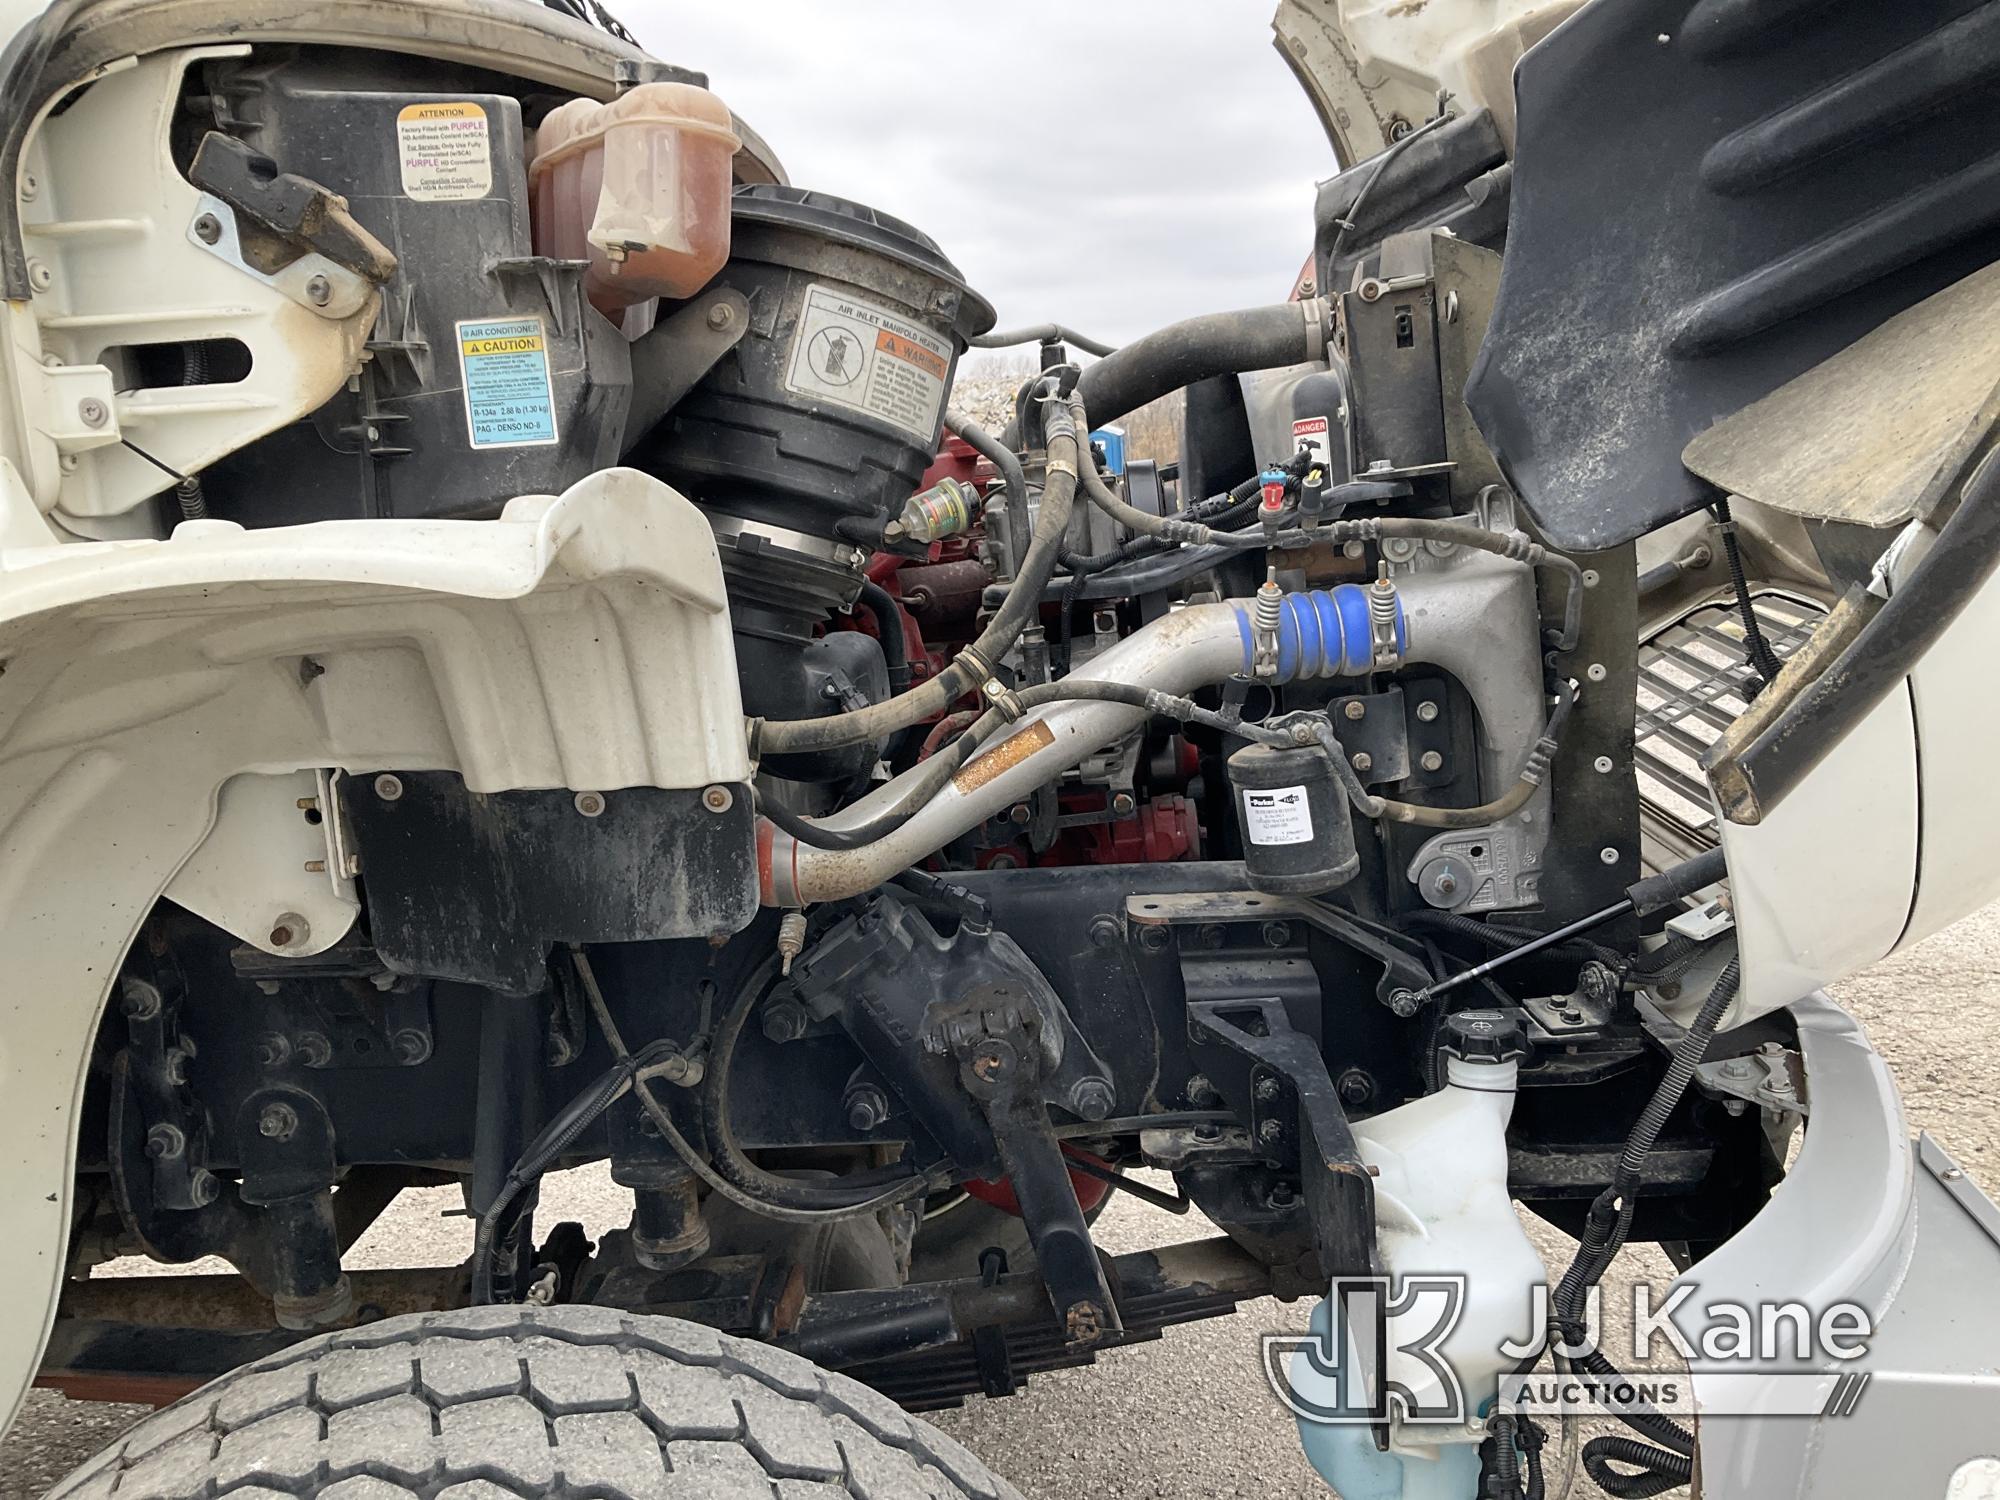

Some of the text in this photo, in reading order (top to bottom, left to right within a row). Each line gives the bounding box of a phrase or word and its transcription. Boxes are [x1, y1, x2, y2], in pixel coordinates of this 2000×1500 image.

[419, 109, 464, 118] ATTENTION
[450, 121, 484, 130] PURPLE
[406, 159, 439, 168] PURPLE
[470, 324, 538, 336] AIR CONDITIONER
[838, 304, 940, 352] AIR INLET MANIFOLD HEATER
[484, 339, 535, 352] CAUTION
[474, 408, 496, 416] R-134a
[523, 406, 538, 414] (1.30
[539, 404, 548, 414] kg)
[476, 425, 492, 433] PAG
[498, 423, 522, 432] DENSO
[1298, 422, 1325, 434] DANGER
